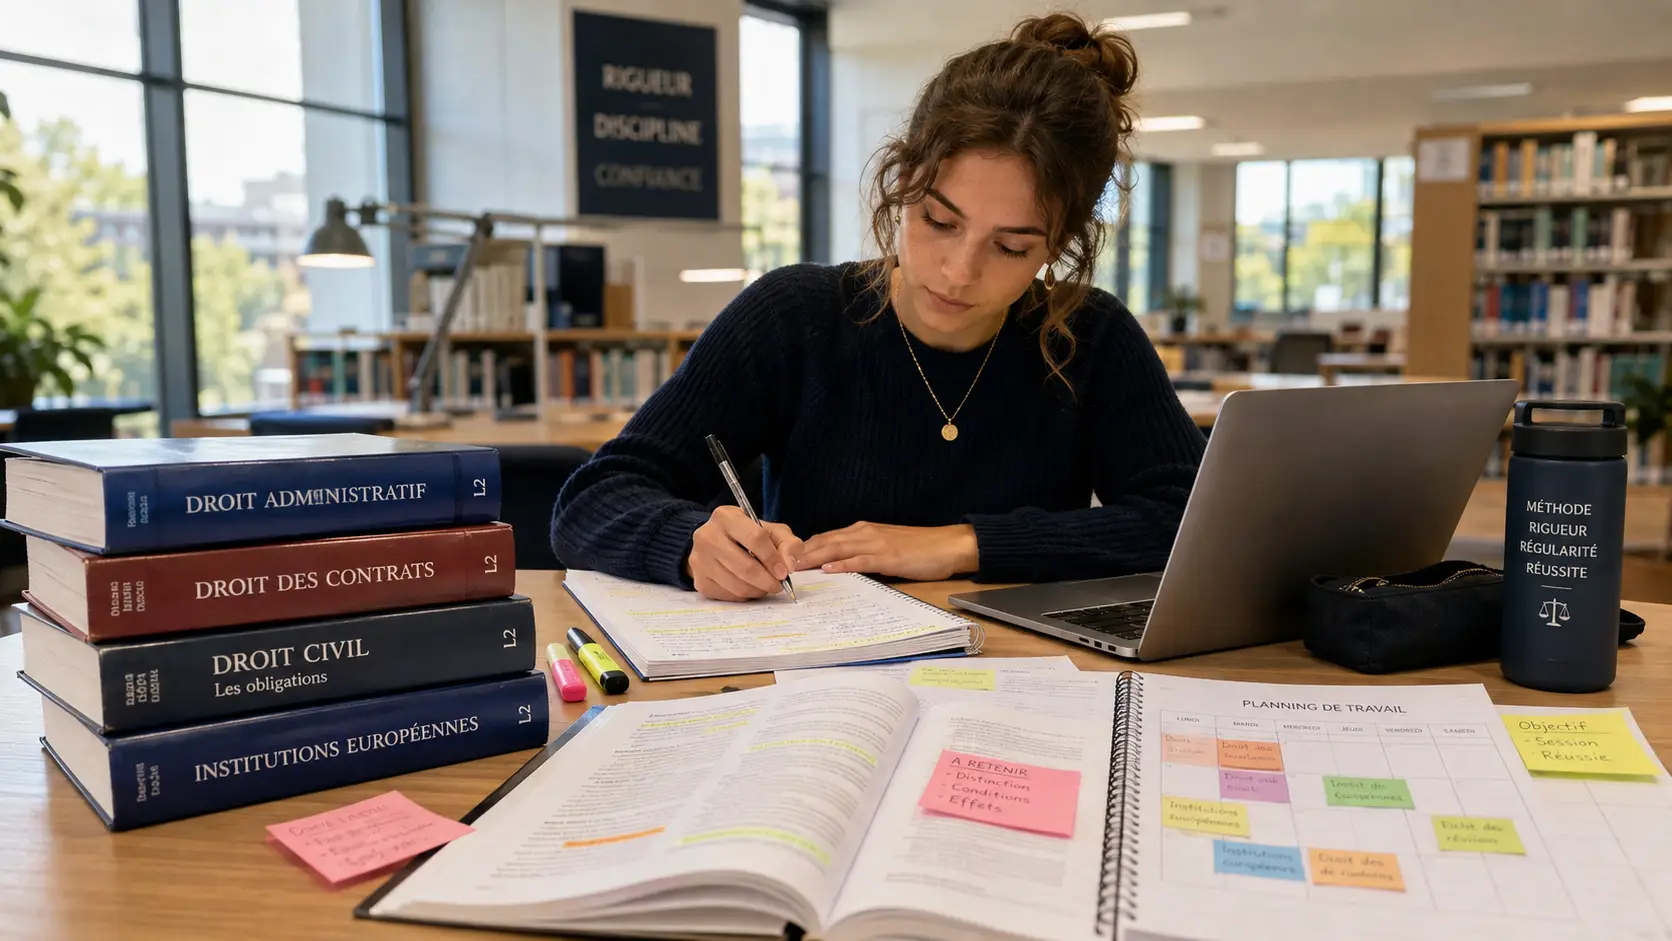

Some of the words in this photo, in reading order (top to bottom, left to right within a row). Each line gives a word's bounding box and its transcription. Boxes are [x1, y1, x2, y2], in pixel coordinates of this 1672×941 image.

[602, 64, 692, 97] RIGUEUR
[594, 112, 703, 145] DISCIPLINE
[594, 162, 703, 192] CONFIANCE
[473, 478, 486, 498] L2
[186, 492, 257, 514] DROIT
[1526, 499, 1592, 516] MÉTHODE
[1529, 521, 1587, 537] RIGUEUR
[1520, 539, 1598, 558] RÉGULARITÉ
[484, 554, 498, 574] L2
[1526, 561, 1588, 579] RÉUSSITE
[195, 576, 269, 600] DROIT
[277, 572, 319, 592] DES
[326, 561, 435, 587] CONTRATS
[503, 628, 517, 648] L2
[212, 646, 295, 675] DROIT
[303, 638, 370, 663] CIVIL
[214, 681, 242, 697] Les
[246, 671, 328, 696] obligations
[518, 704, 531, 725] L2
[1242, 699, 1318, 712] PLANNING
[1322, 703, 1342, 713] DE
[1346, 703, 1407, 714] TRAVAIL
[1519, 721, 1588, 733] Objectif
[194, 740, 340, 782] INSTITUTIONS
[346, 715, 480, 754] EUROPÉENNES
[1535, 736, 1599, 748] Session
[1541, 750, 1611, 762] Réussie
[967, 759, 1028, 777] RETENIR
[956, 771, 1030, 791] Distinction
[951, 783, 1031, 804] Conditions
[949, 795, 1003, 813] Effets
